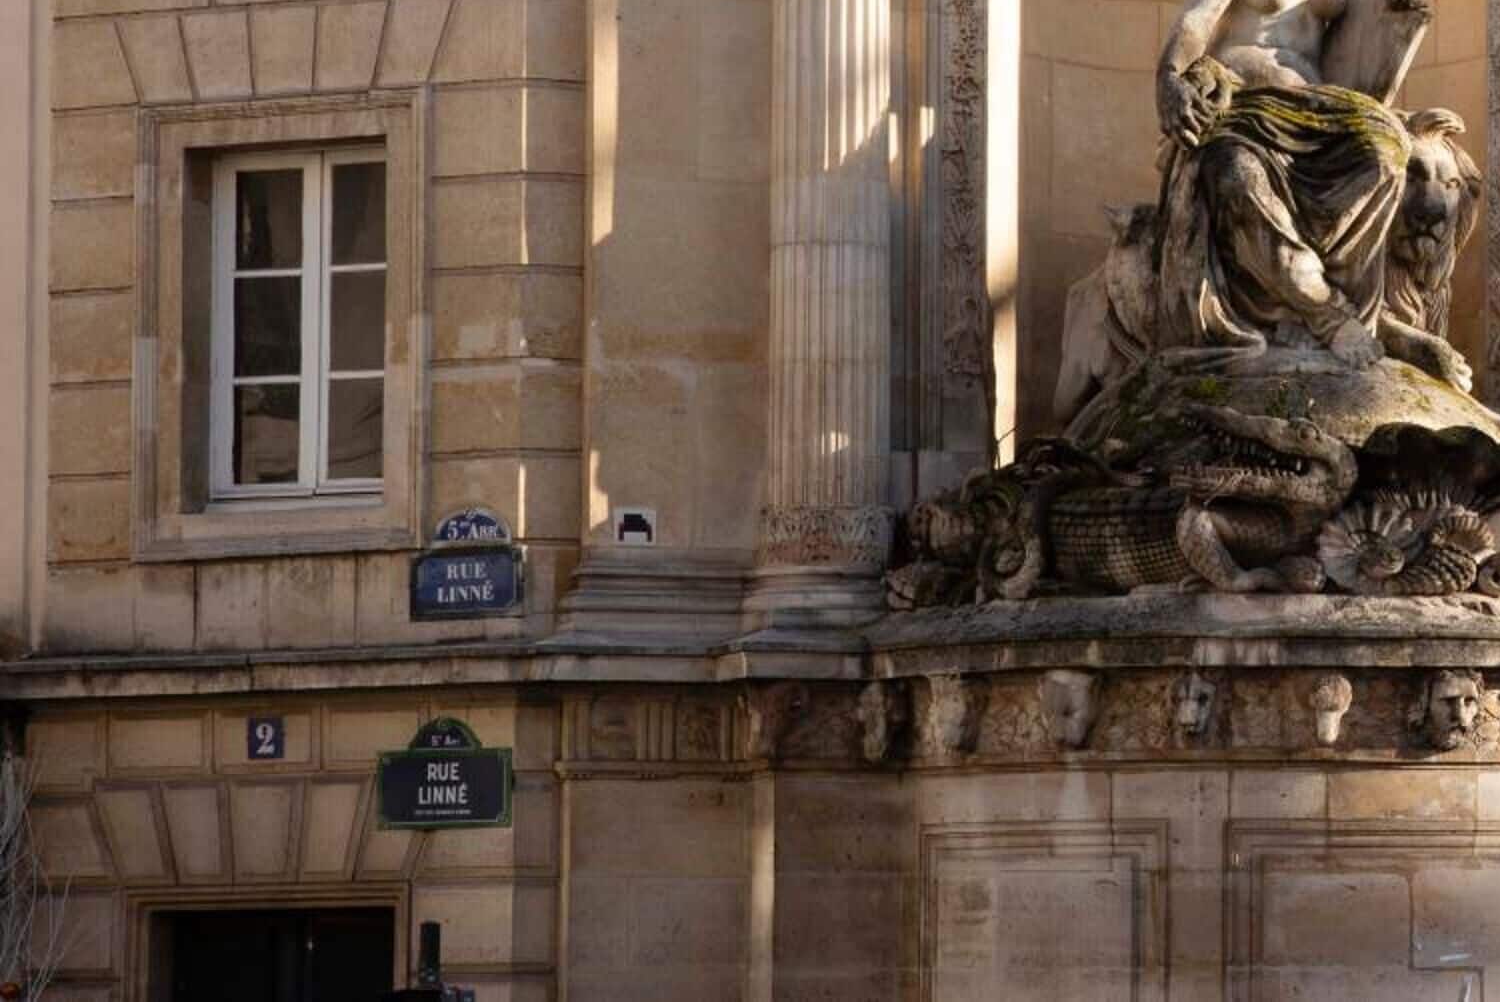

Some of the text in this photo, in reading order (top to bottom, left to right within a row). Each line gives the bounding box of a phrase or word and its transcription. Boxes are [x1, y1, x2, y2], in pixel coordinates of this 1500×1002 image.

[447, 562, 488, 580] RUE
[437, 580, 496, 604] LINNÉ
[255, 724, 275, 755] 2
[427, 761, 460, 782] RUE
[418, 781, 469, 805] LINNÉ
